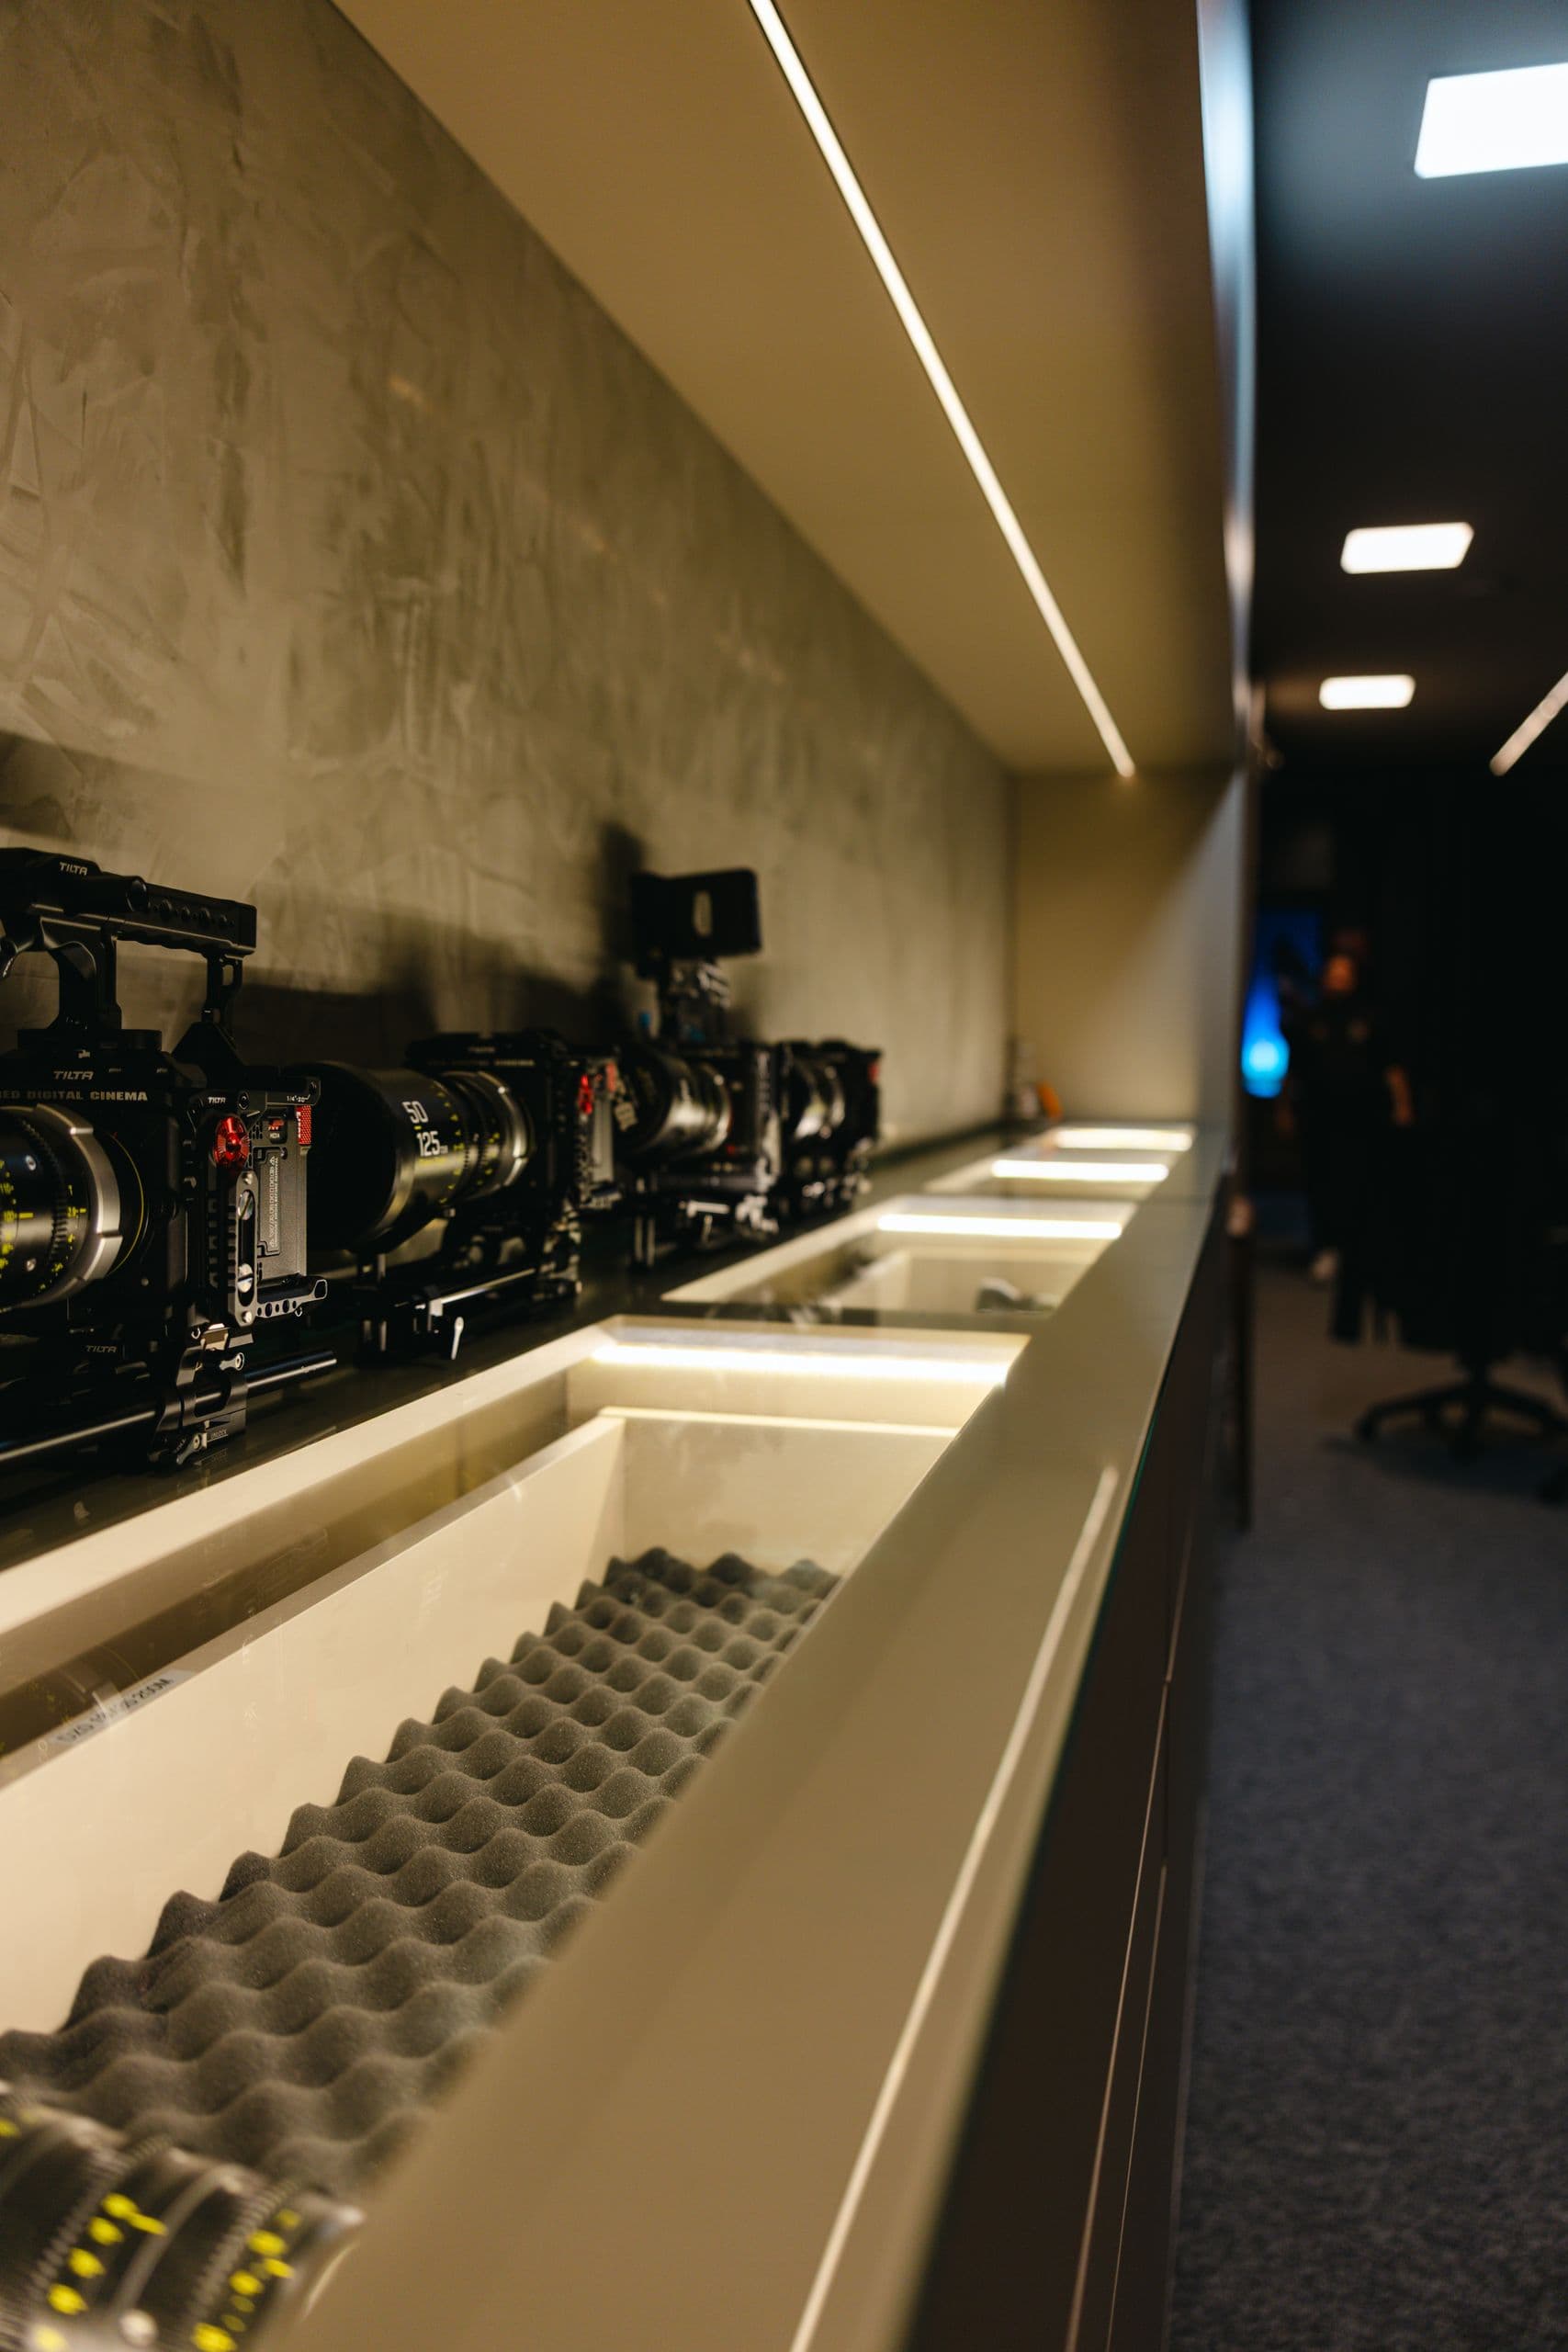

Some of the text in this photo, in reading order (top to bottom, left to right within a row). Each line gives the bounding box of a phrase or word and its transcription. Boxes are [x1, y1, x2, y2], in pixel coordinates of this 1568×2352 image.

[59, 861, 88, 876] TILTA
[52, 1069, 96, 1080] TILTA
[27, 1090, 84, 1101] DIGITAL
[89, 1091, 148, 1102] CINEMA
[208, 1096, 227, 1104] TILTA
[401, 1100, 430, 1124] 50
[86, 1345, 118, 1353] TILTA
